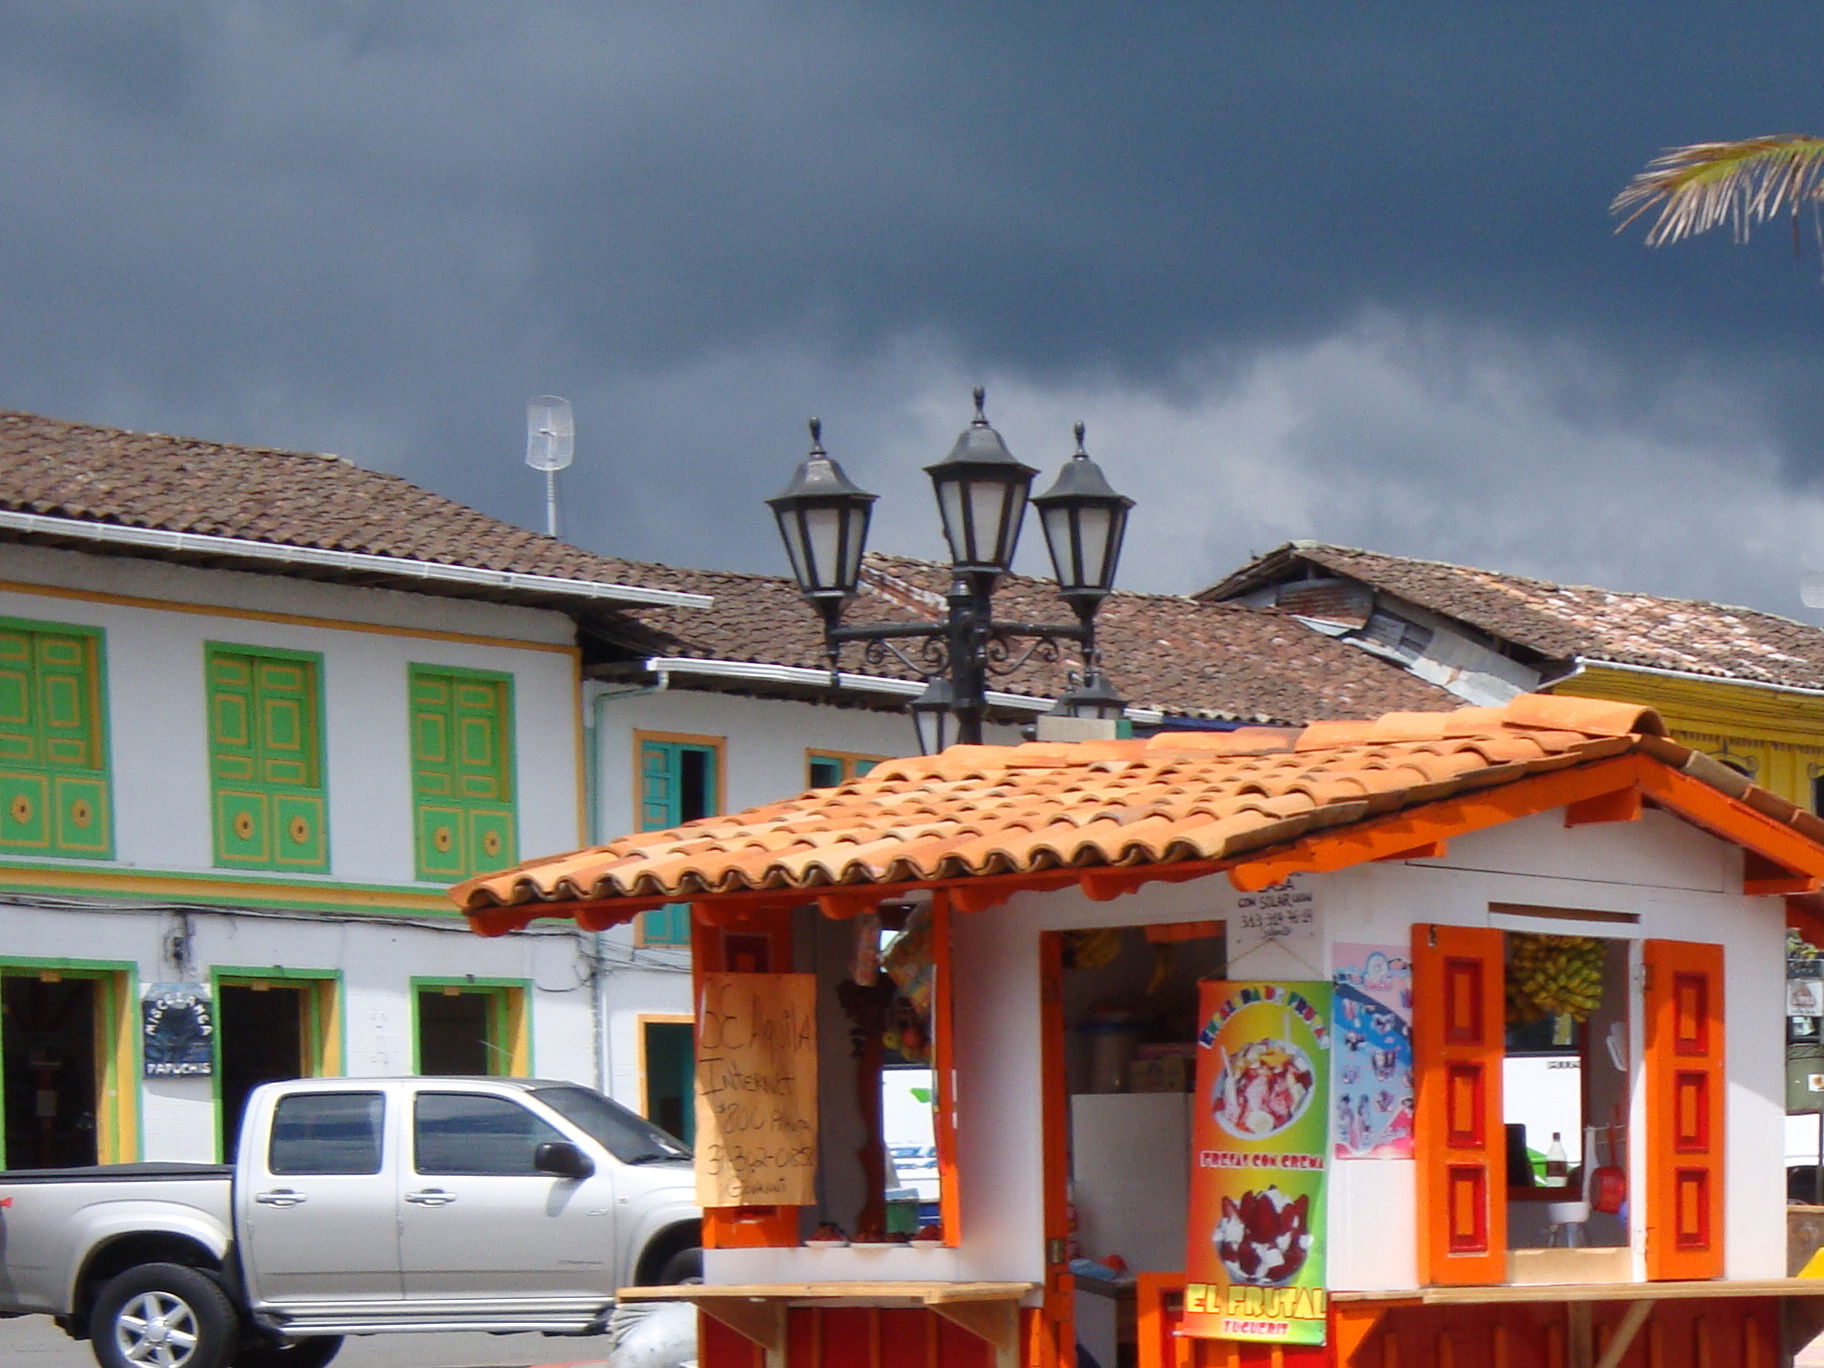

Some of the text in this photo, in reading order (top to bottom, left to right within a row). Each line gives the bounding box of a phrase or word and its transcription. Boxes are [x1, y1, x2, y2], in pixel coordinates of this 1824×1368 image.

[1263, 984, 1285, 1004] DE
[1200, 1151, 1327, 1171] FRESAS CON CREMA
[1187, 1284, 1327, 1320] EL FRUTAL
